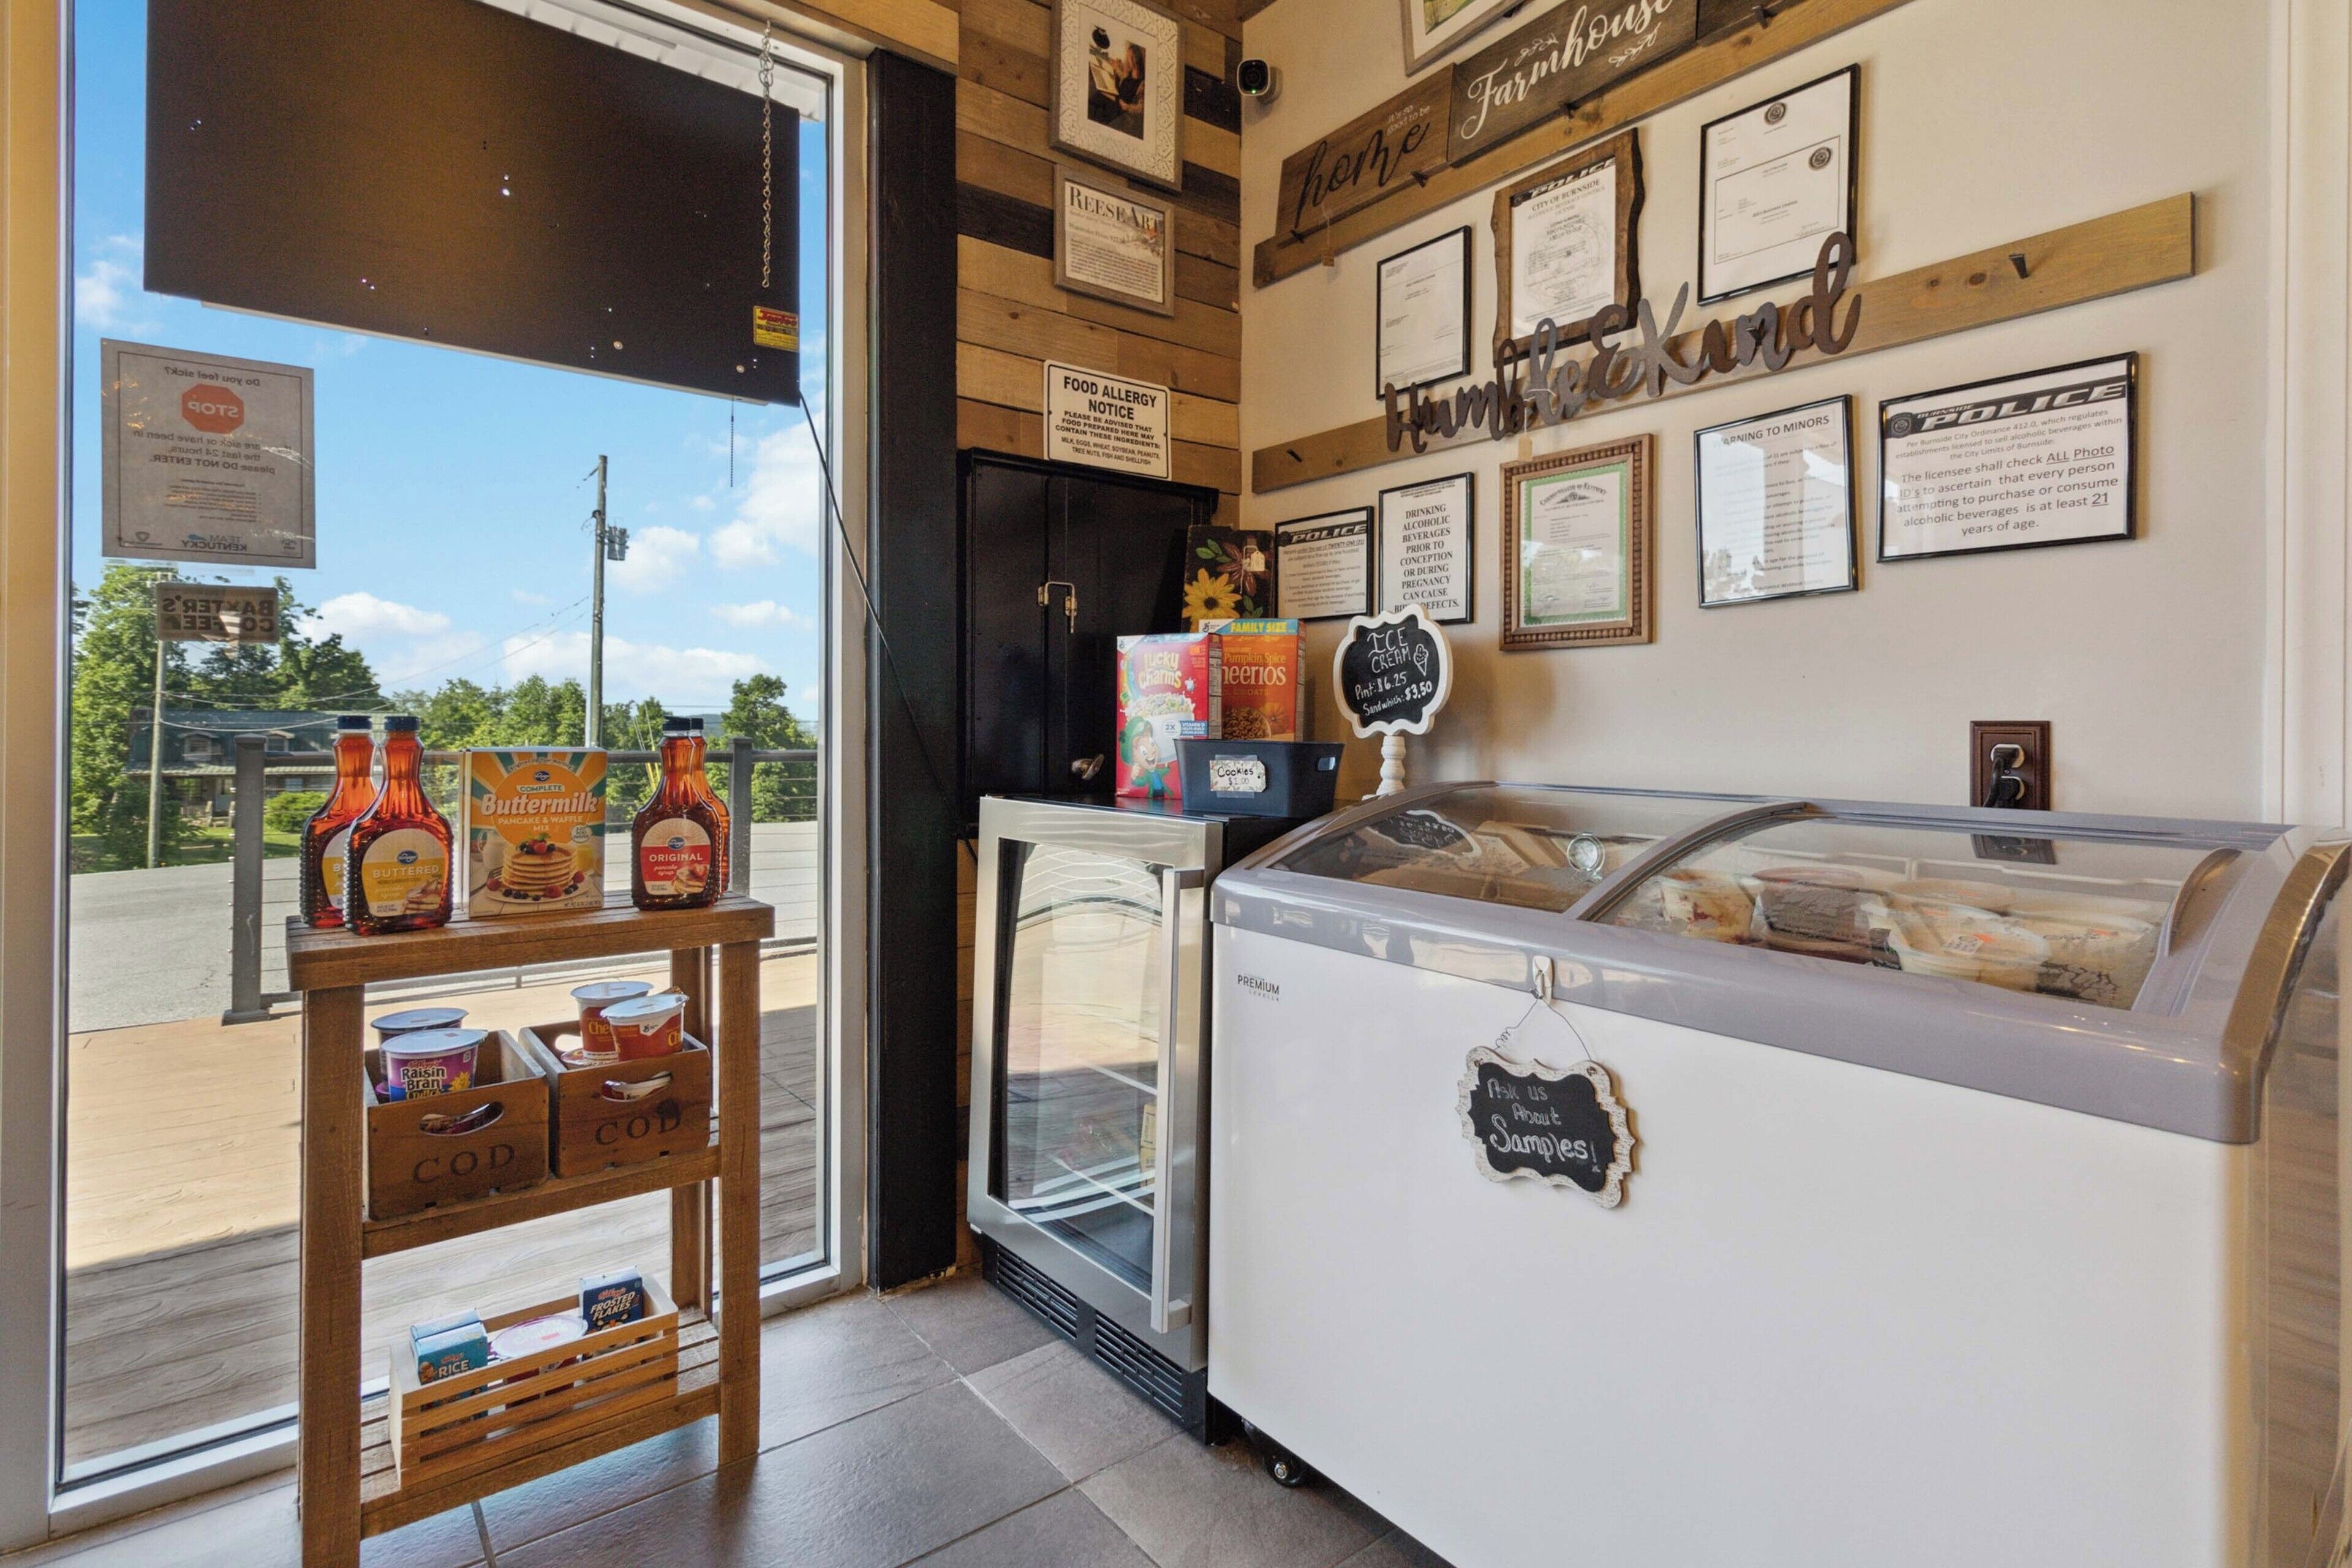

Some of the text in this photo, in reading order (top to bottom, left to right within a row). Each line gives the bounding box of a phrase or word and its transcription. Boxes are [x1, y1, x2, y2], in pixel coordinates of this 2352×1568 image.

[1295, 122, 1430, 229] home
[1532, 178, 1600, 211] CITY OF BURNSIDE
[1070, 186, 1126, 223] REESE
[1131, 206, 1161, 232] ART
[1385, 318, 1591, 453] Humble
[1637, 232, 1861, 398] Kind
[1064, 376, 1156, 407] FOOD ALLERGY
[1089, 399, 1134, 420] NOTICE
[1917, 404, 1974, 419] BURNSIDE
[1921, 381, 2125, 431] POLICE
[1065, 410, 1091, 420] PLEASE
[1104, 418, 1133, 429] ADVISED
[1084, 422, 1119, 434] PREPARED
[1121, 429, 1138, 438] HERE
[1920, 435, 1953, 446] Burnside
[1954, 432, 1969, 442] City
[1970, 426, 2011, 437] Ordinance
[2040, 415, 2066, 426] which
[2068, 409, 2108, 423] regulates
[1055, 424, 1161, 449] CONTAIN THESE INGREDIENTS:
[1719, 415, 1830, 447] ARNING TO MINORS
[1896, 445, 1950, 459] establishments
[1951, 440, 1983, 451] licensed
[1994, 435, 2008, 444] sell
[2010, 429, 2046, 442] alcoholic
[2048, 423, 2092, 437] beverages
[2094, 417, 2122, 428] within
[1072, 447, 1085, 455] TREE
[1126, 456, 1151, 466] SHELLFISH
[1964, 450, 1980, 459] City
[1981, 445, 2004, 456] Limits
[1902, 445, 2114, 484] The licensee shall check ALL Photo
[1900, 461, 2115, 499] ID's to ascertain that every person
[1896, 477, 2119, 514] attempting to purchase or consume
[1406, 503, 1446, 519] DRINKING
[1904, 492, 2109, 527] alcoholic beverages is at least 21
[1291, 524, 1367, 543] POLICE
[1403, 515, 1450, 531] ALCOHOLIC
[1961, 519, 2040, 537] years of age.
[1403, 527, 1450, 543] BEVERAGES
[1406, 541, 1444, 554] PRIOR TO
[1400, 551, 1452, 566] CONCEPTION
[1417, 564, 1449, 576] DURING
[1401, 575, 1452, 589] PREGNANCY
[1403, 588, 1448, 601] CAN CAUSE
[1231, 622, 1264, 633] FAMILY
[1266, 622, 1287, 633] SIZE
[1367, 627, 1408, 658] ICE
[1225, 652, 1286, 666] Pumpkin Spice
[1371, 646, 1411, 673] CREAM
[1355, 671, 1407, 700] Pint: $6.25
[1405, 680, 1432, 701] $3.50
[1217, 765, 1254, 778] Cookies
[1228, 777, 1250, 786] $1.00
[481, 791, 598, 816] Buttermilk
[499, 816, 540, 825] PANCAKE
[649, 852, 703, 862] ORIGINAL
[372, 865, 439, 879] BUTTERED
[1237, 974, 1280, 995] PREMIUM
[401, 1067, 446, 1080] Raisin
[406, 1079, 441, 1091] Bran
[1487, 1078, 1519, 1099] Ask
[1512, 1102, 1561, 1125] About
[595, 1109, 682, 1145] COD
[413, 1144, 514, 1183] COD
[590, 1291, 635, 1314] FROSTED
[592, 1300, 631, 1321] FLAKES
[438, 1359, 469, 1378] RICE
